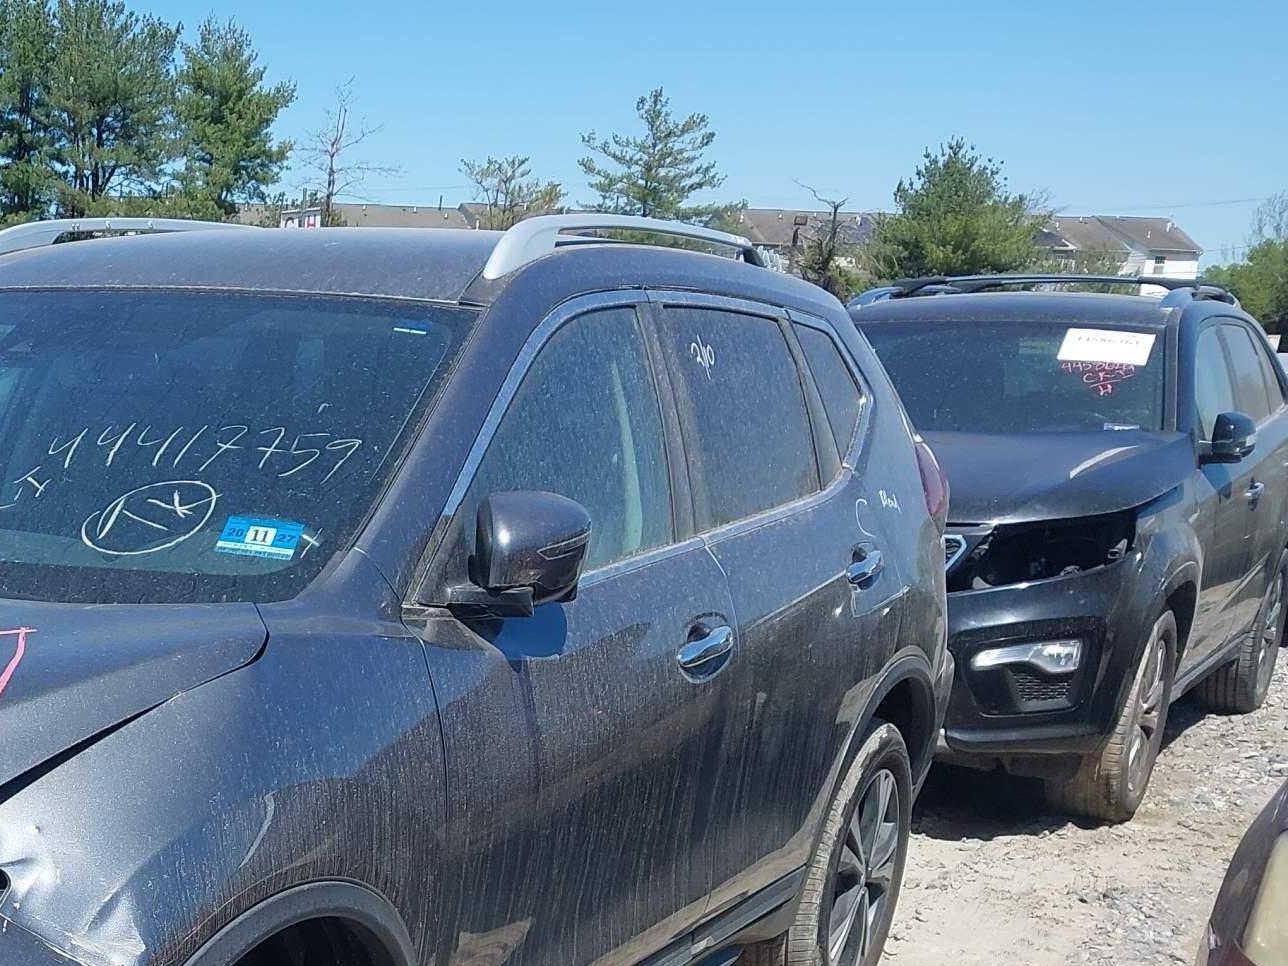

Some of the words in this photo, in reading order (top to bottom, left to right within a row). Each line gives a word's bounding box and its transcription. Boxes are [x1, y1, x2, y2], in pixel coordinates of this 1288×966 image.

[47, 422, 363, 484] 44417759
[228, 527, 245, 538] 20
[250, 528, 270, 544] 11
[277, 533, 297, 543] 27
